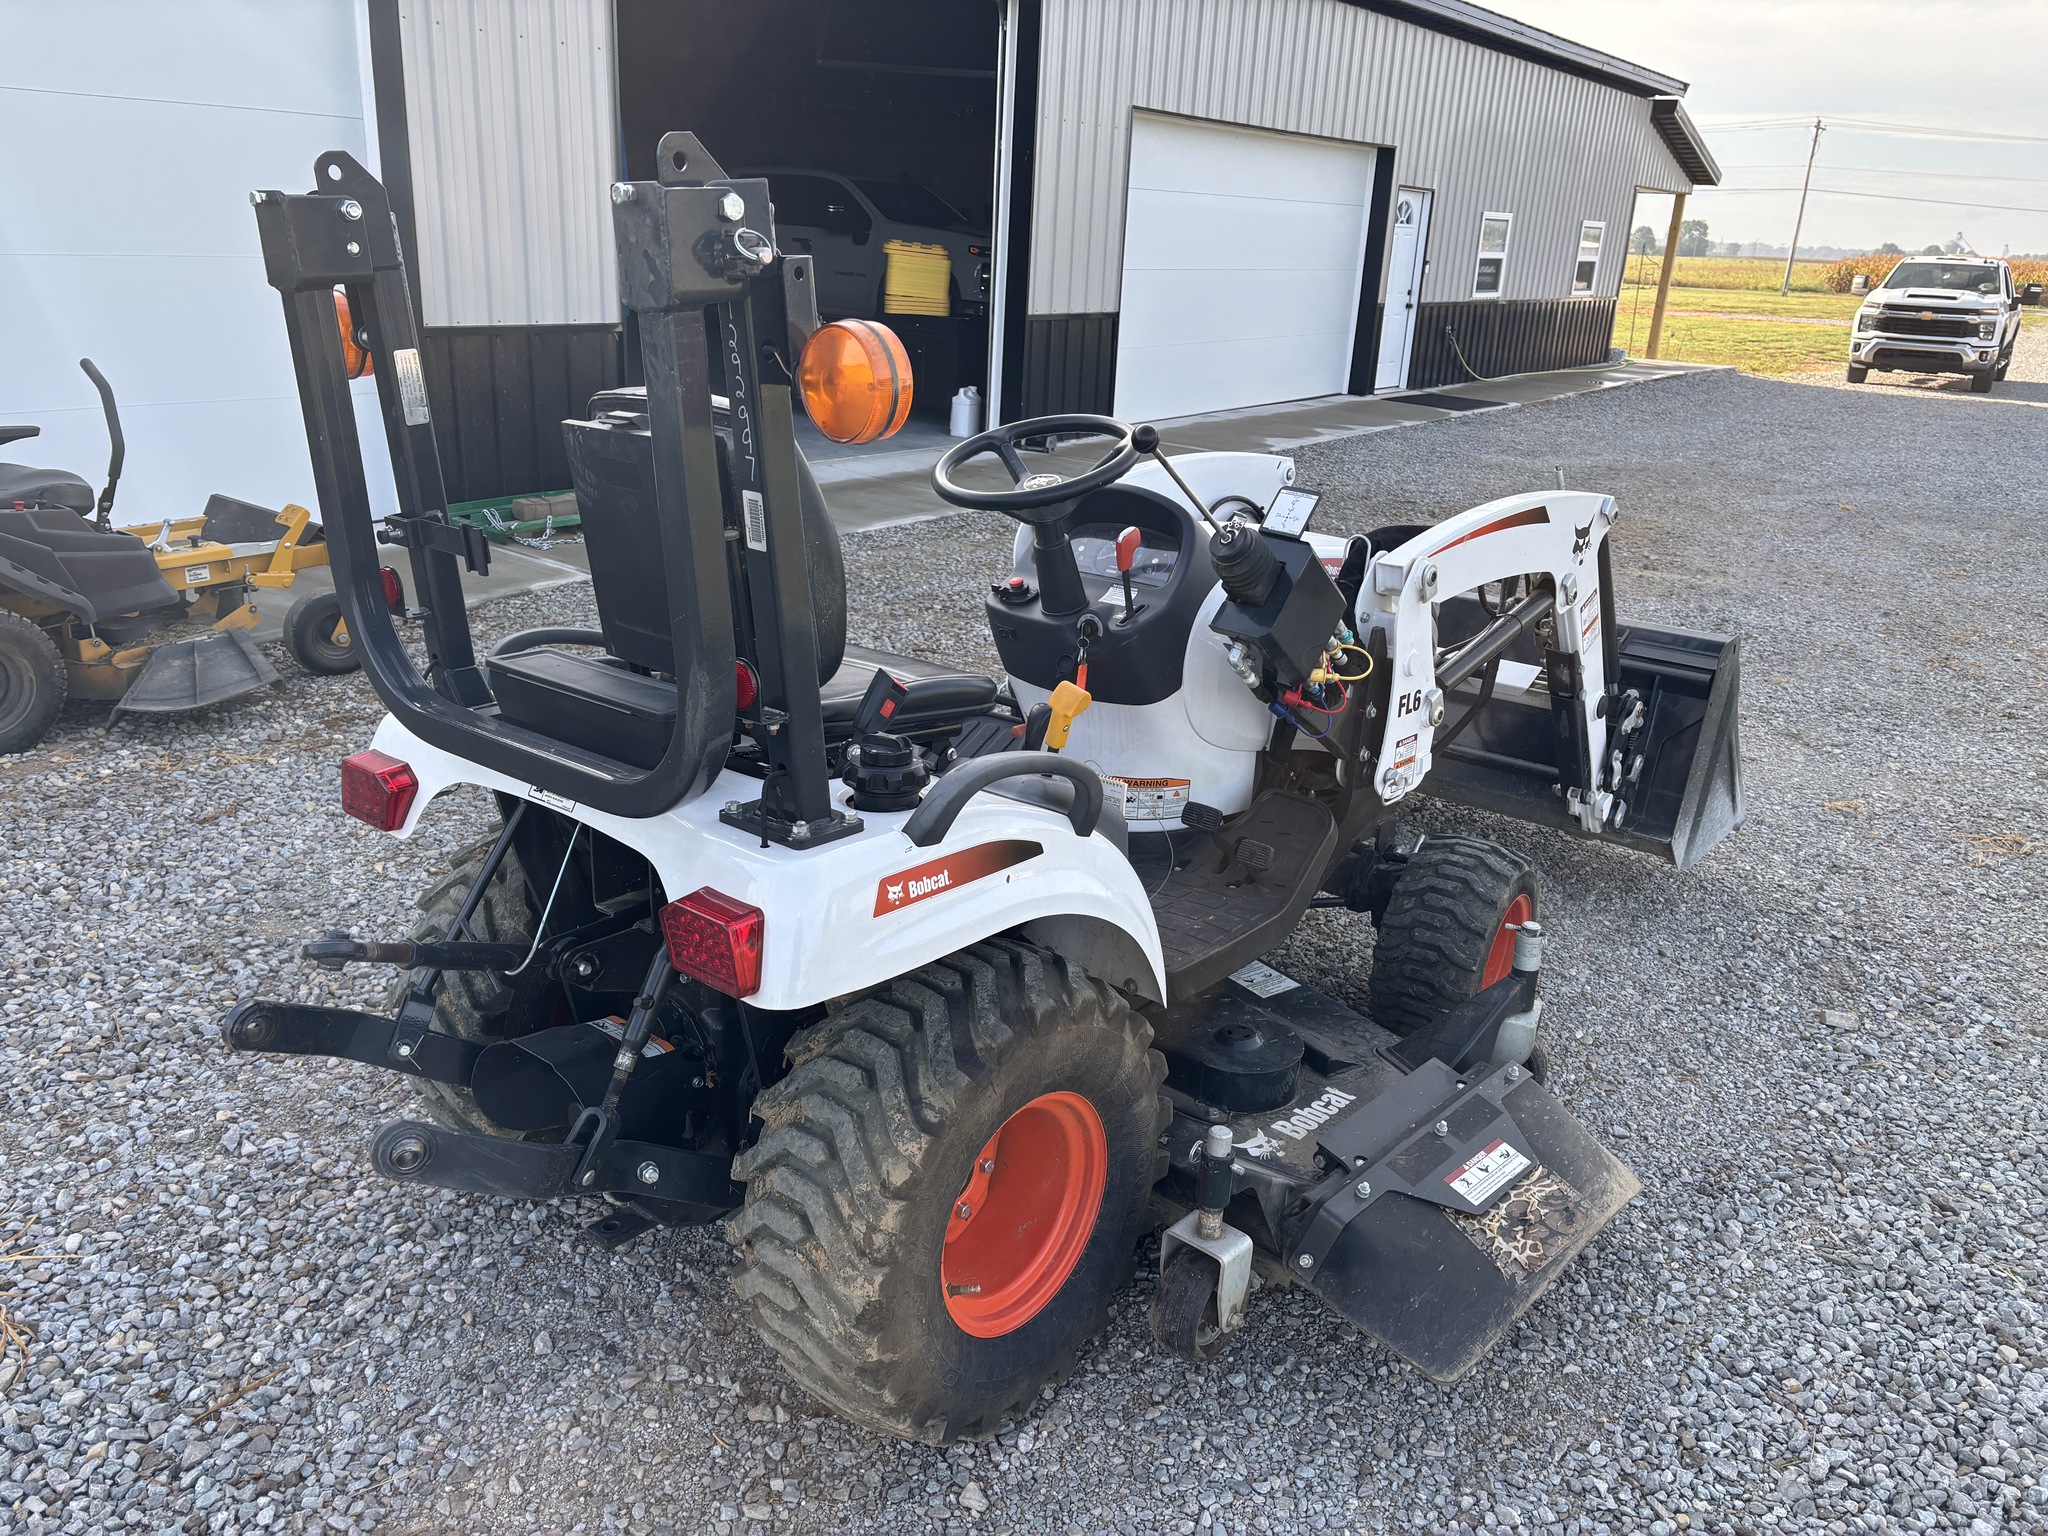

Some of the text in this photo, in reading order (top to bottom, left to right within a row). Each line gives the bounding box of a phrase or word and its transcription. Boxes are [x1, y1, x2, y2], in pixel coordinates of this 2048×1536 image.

[1397, 689, 1422, 718] FL6
[1124, 779, 1169, 787] WARNING
[908, 869, 949, 897] Bobcat
[1270, 1086, 1357, 1140] Bobcat
[1466, 1150, 1488, 1168] DANGER
